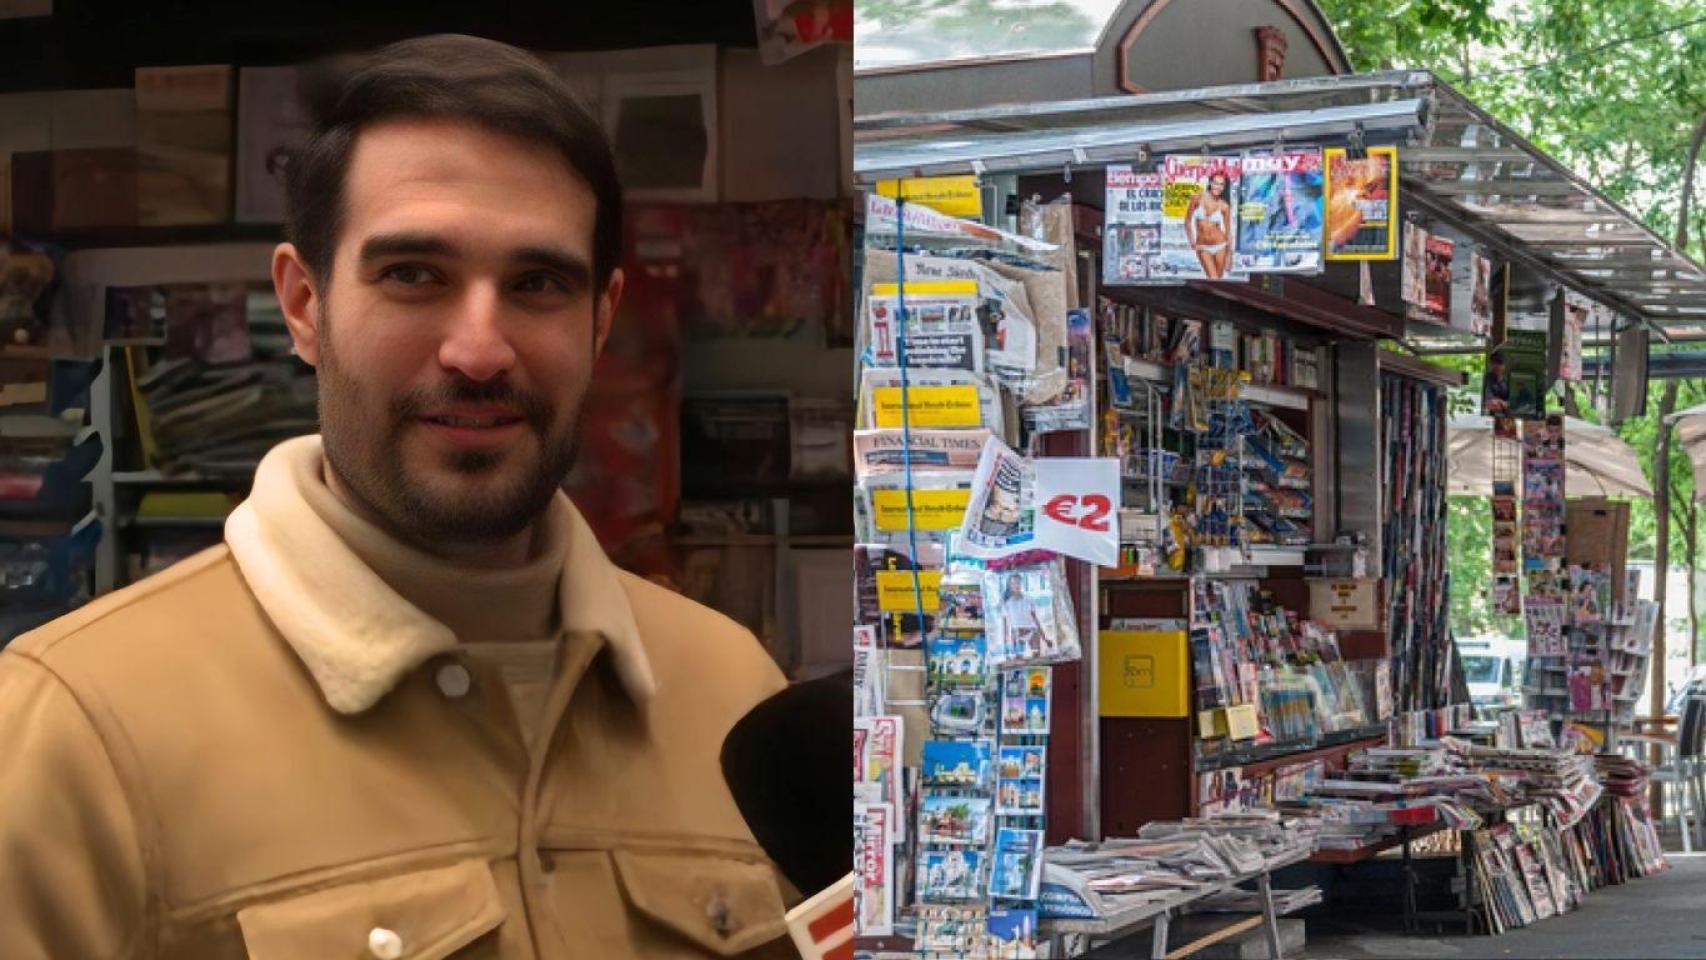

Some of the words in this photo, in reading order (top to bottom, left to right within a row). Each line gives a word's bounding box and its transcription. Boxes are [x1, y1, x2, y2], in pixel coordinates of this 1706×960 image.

[1241, 155, 1299, 174] muy
[873, 433, 940, 449] FINACIAL
[942, 437, 981, 449] TIMES
[1042, 494, 1111, 532] €2
[864, 812, 884, 883] Mirror
